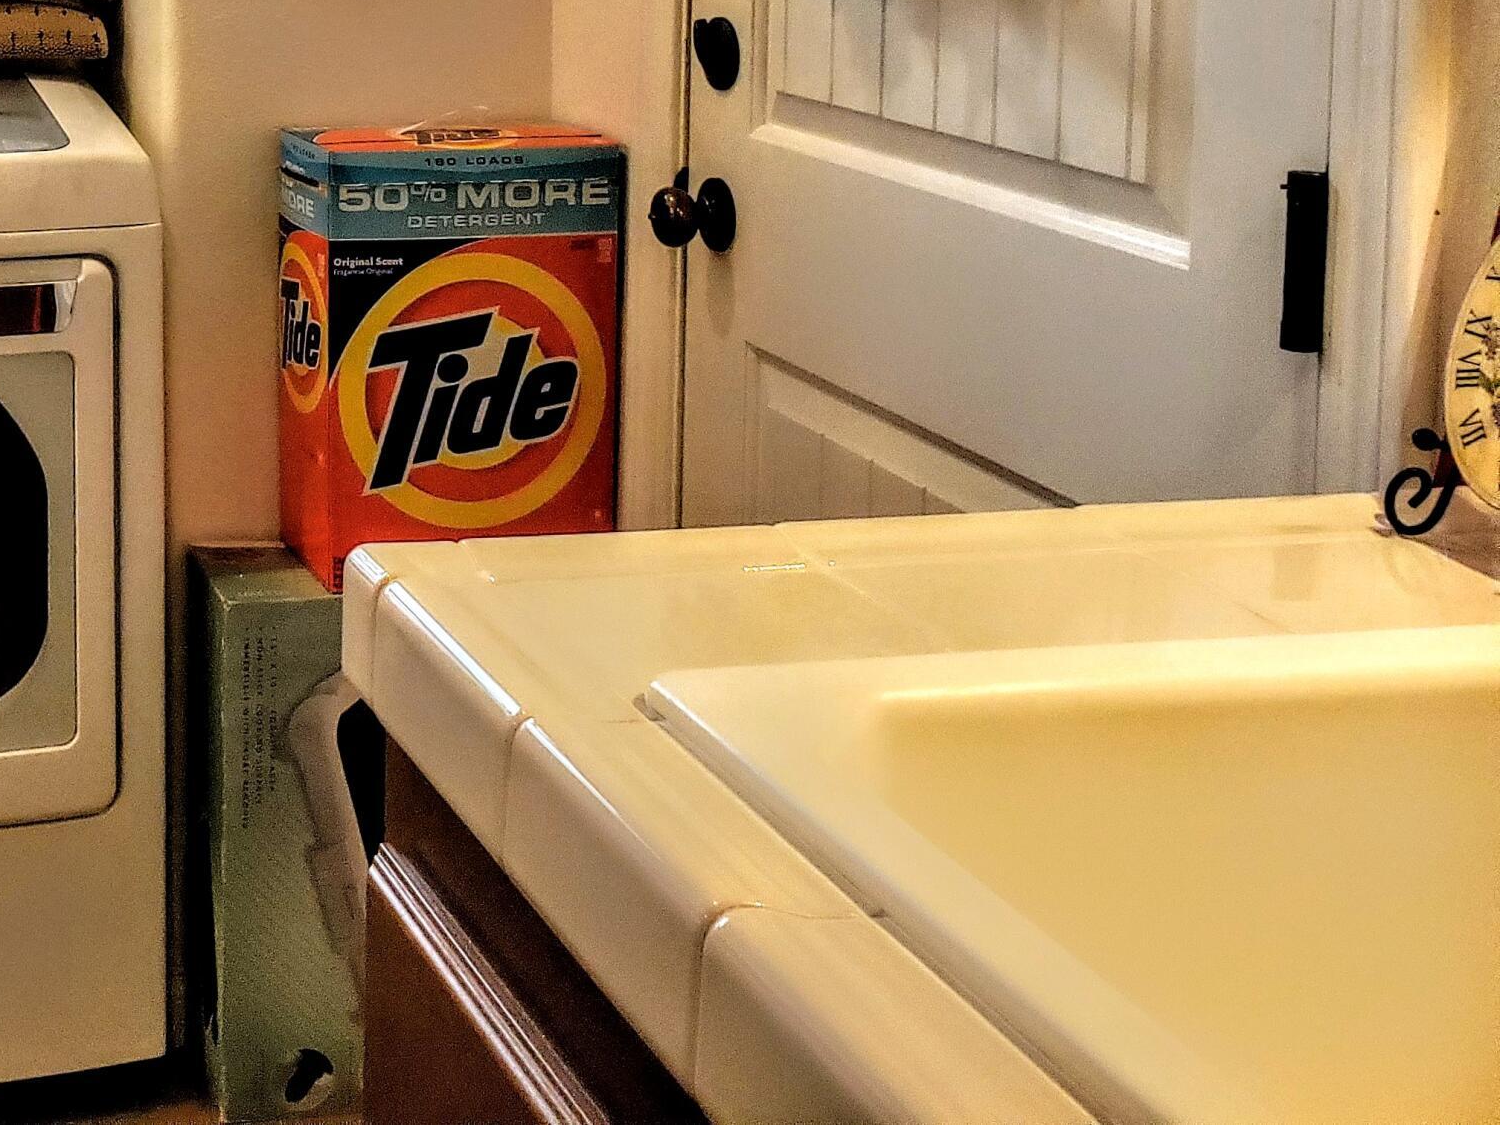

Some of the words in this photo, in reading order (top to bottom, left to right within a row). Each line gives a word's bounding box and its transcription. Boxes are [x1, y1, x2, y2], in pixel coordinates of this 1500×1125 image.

[466, 156, 525, 166] LOADS
[338, 180, 447, 212] 50%
[457, 177, 610, 209] MORE
[407, 212, 547, 228] DETERGENT
[333, 256, 374, 268] Original
[376, 257, 404, 266] Scent
[280, 276, 322, 370] Tide
[364, 307, 580, 495] Tide
